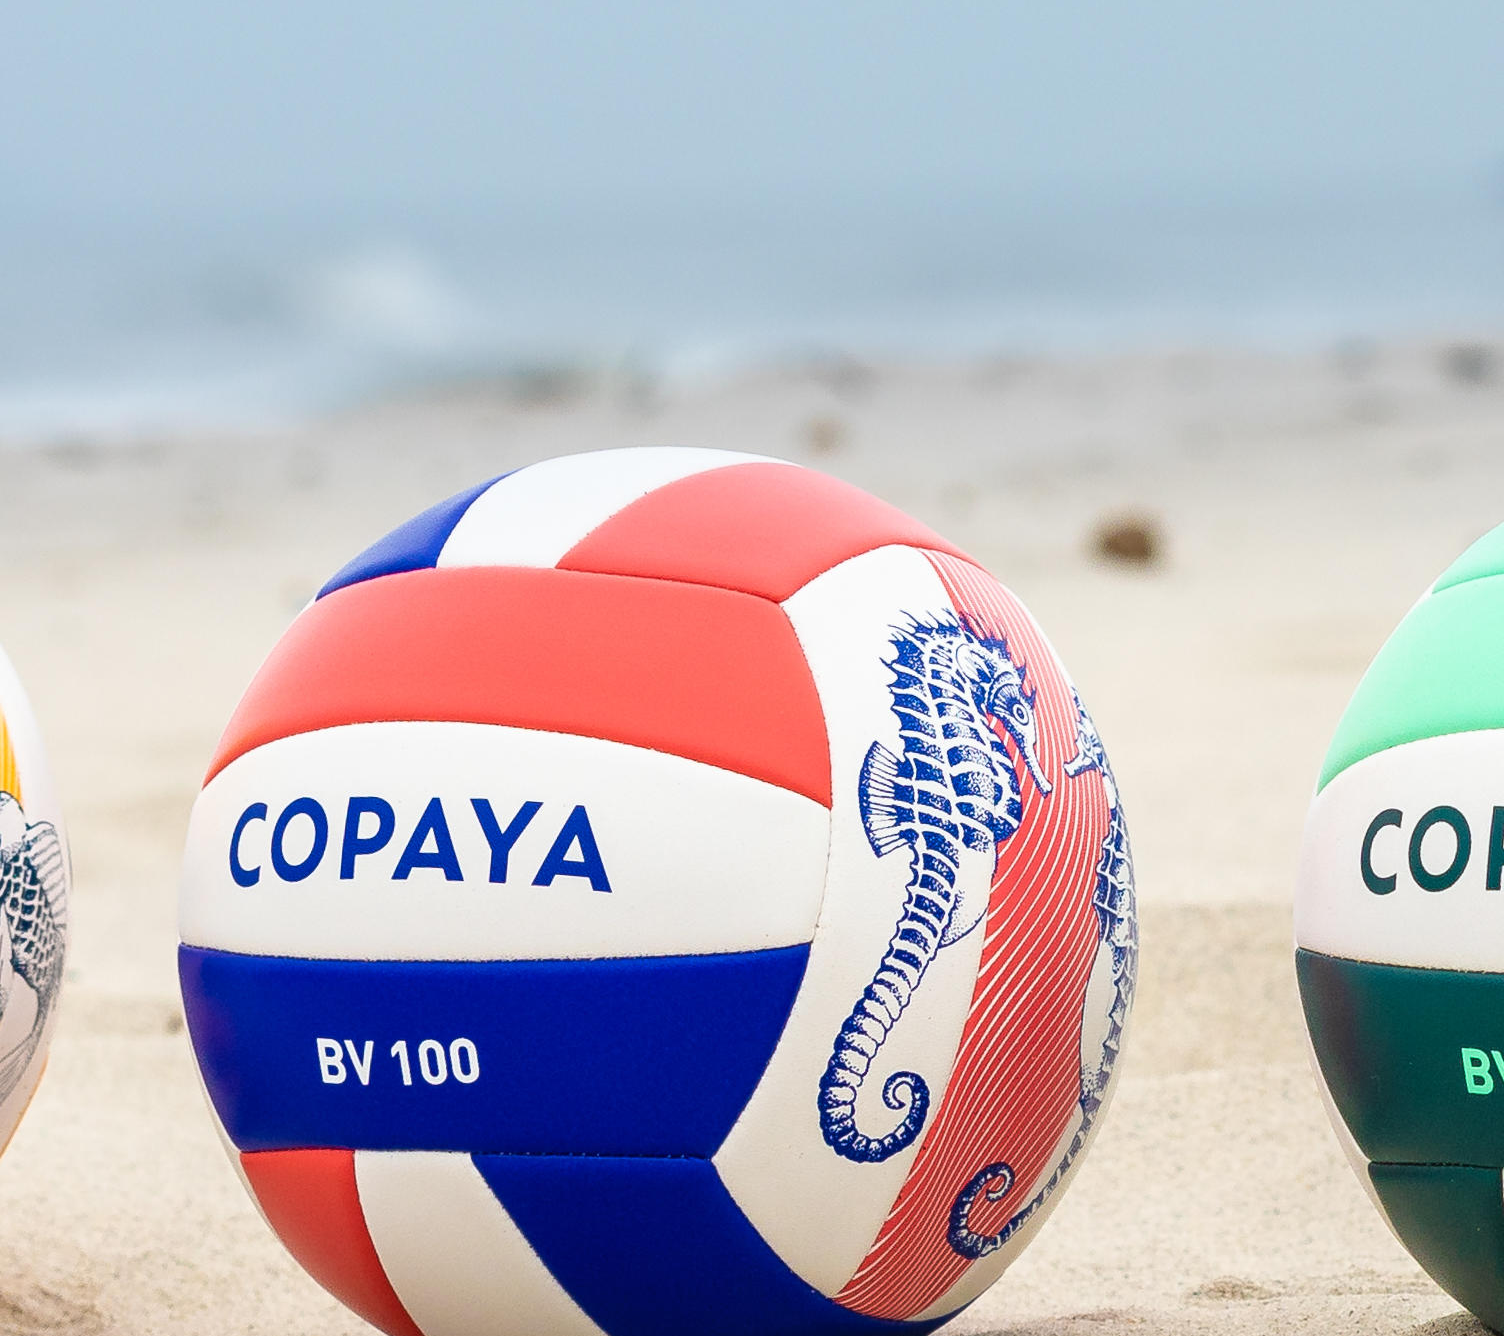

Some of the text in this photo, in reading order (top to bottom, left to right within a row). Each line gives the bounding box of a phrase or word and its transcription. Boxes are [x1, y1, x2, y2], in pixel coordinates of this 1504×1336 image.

[229, 796, 613, 894] COPAYA
[316, 1037, 480, 1086] BV 100
